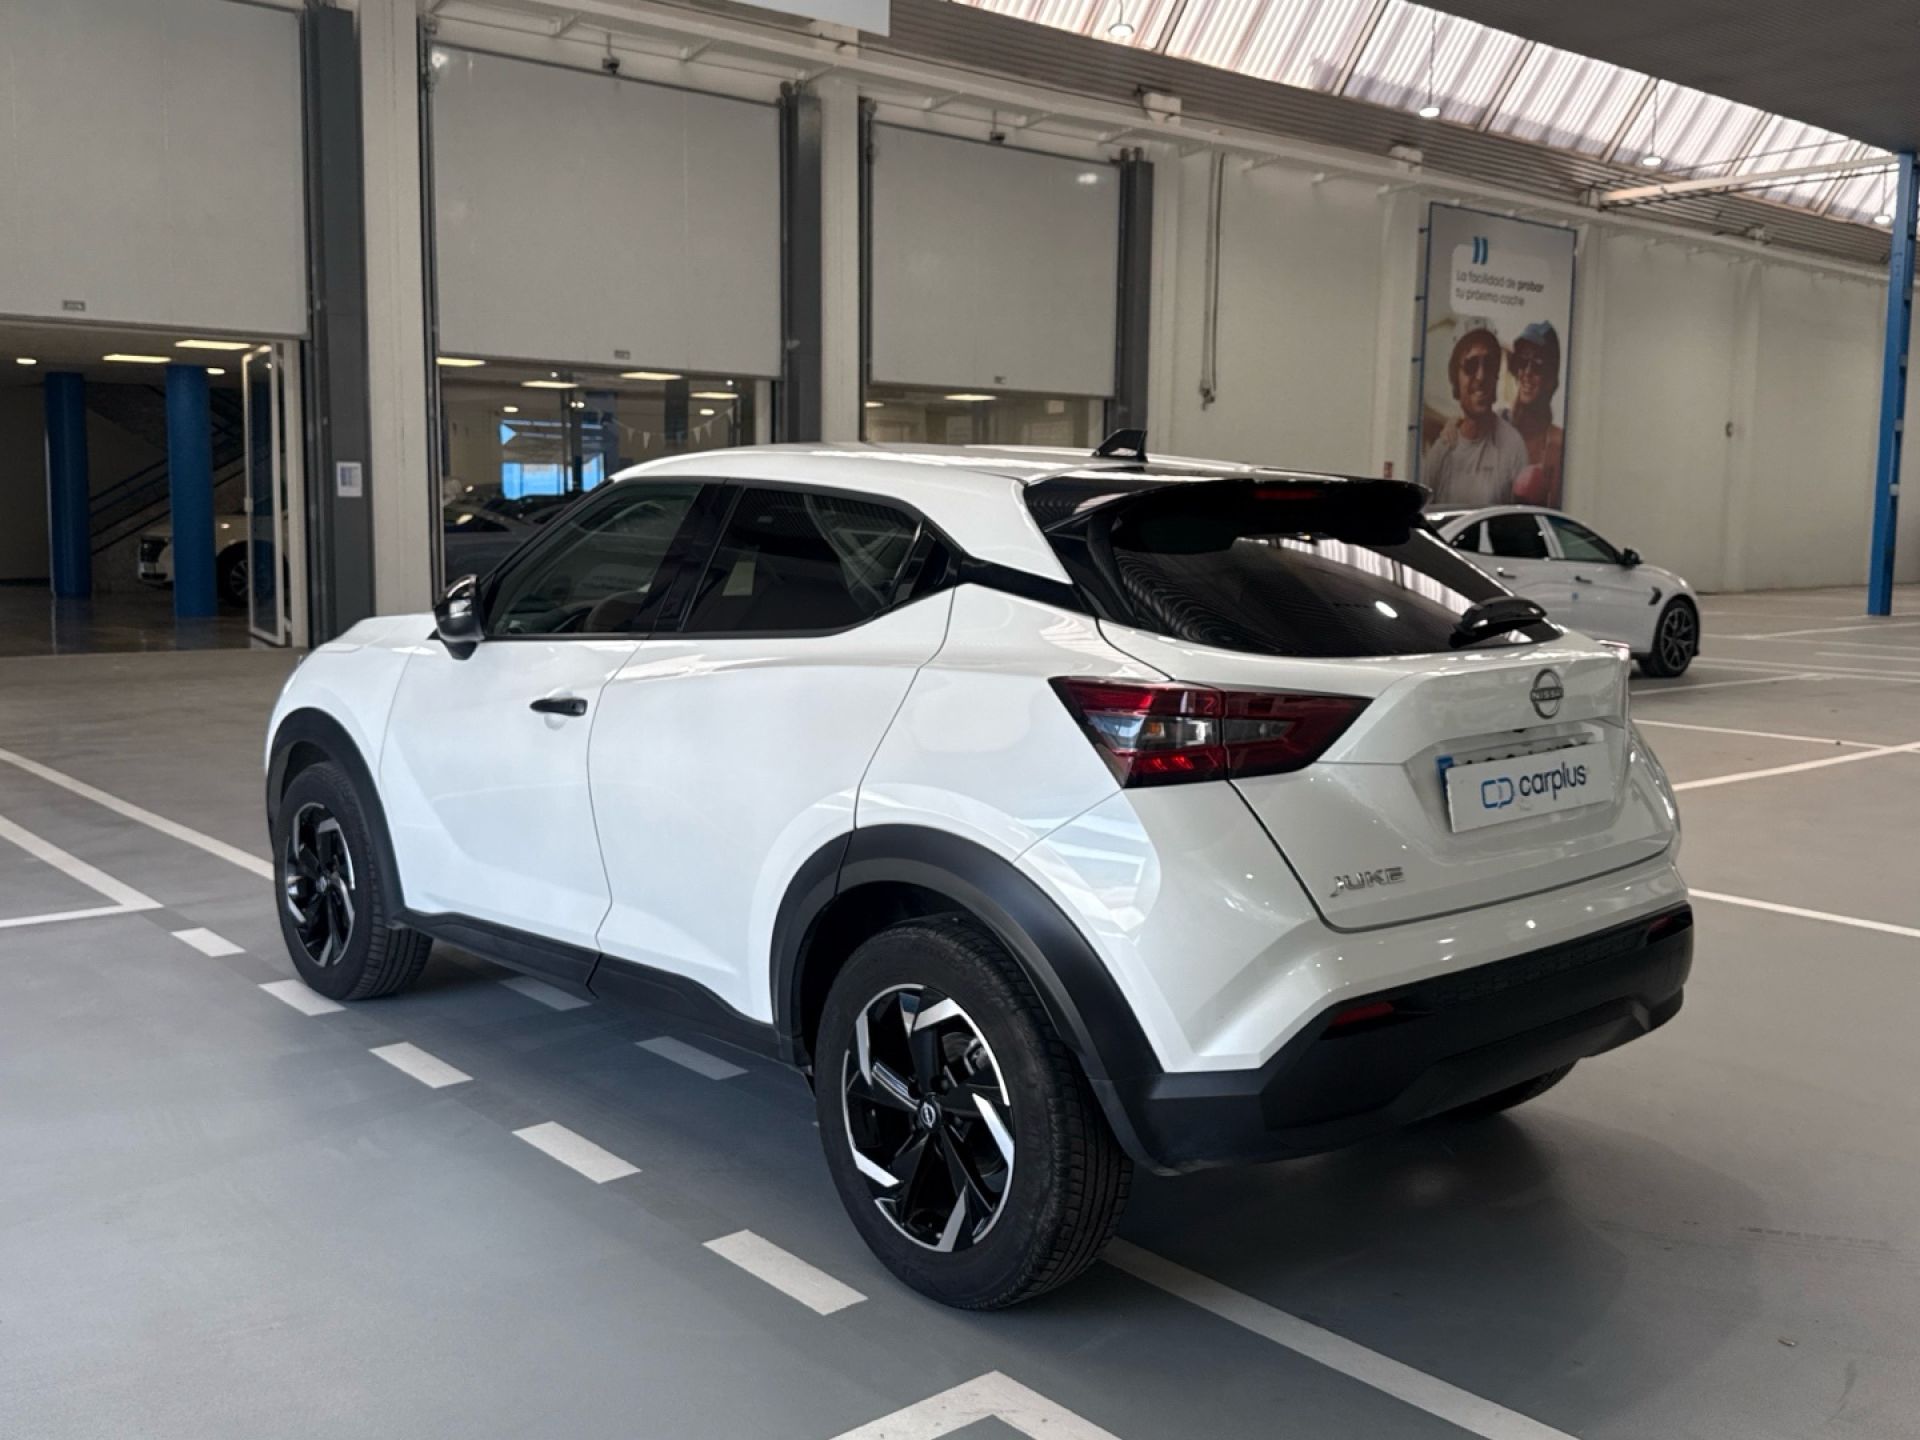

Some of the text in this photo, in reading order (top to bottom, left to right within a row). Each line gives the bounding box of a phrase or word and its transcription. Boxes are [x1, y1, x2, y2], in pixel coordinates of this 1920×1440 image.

[1456, 270, 1545, 294] La facilidad de probar
[1500, 294, 1526, 307] coche
[1519, 761, 1587, 800] carplus
[1330, 866, 1404, 898] JUKE
